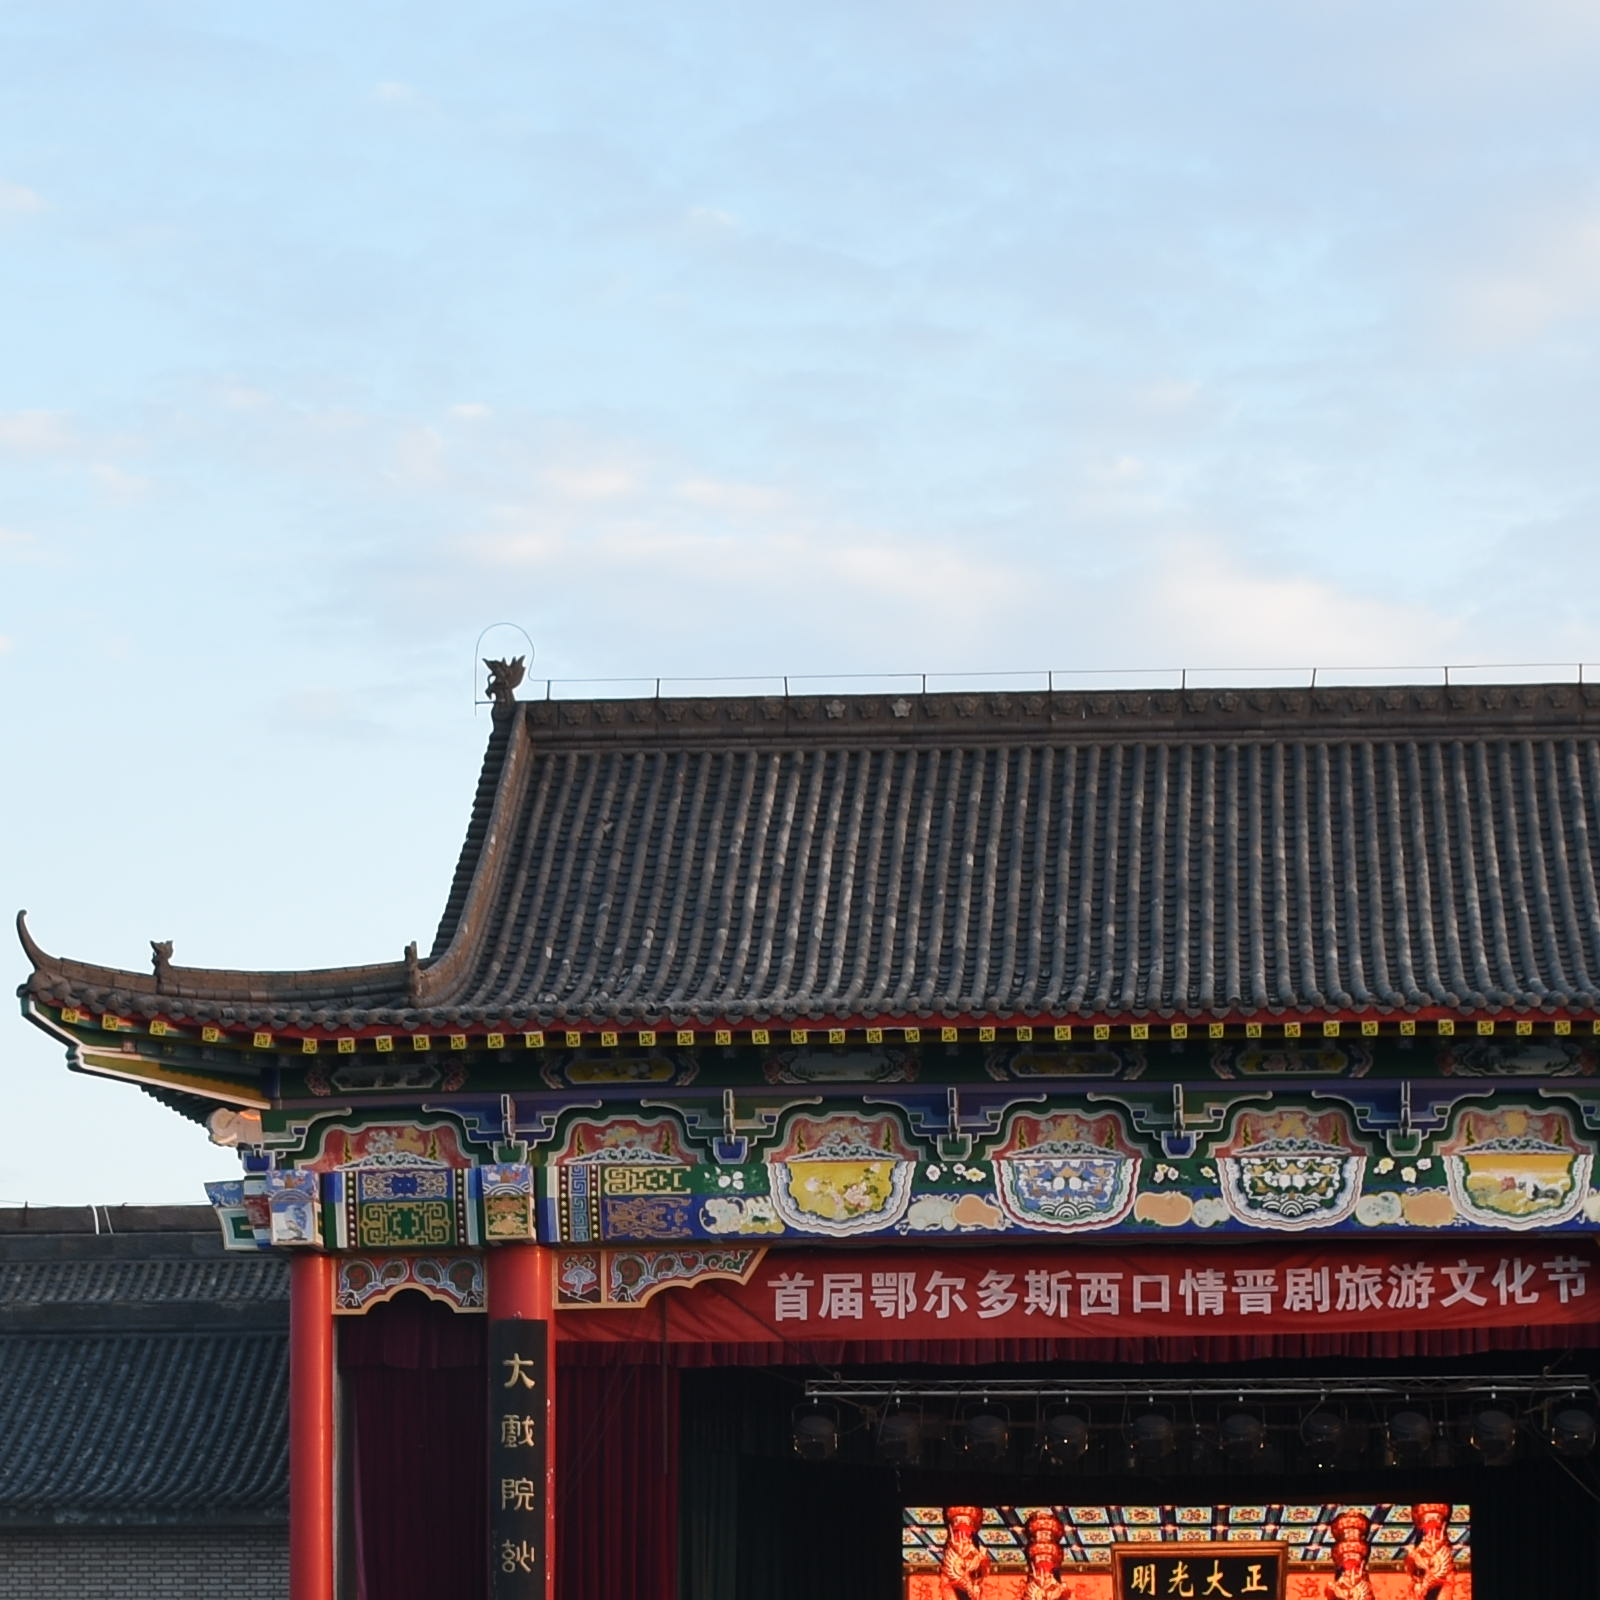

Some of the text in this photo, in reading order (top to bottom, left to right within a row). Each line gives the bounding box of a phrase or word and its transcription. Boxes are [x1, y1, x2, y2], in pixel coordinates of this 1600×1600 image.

[767, 1254, 1592, 1321] 首届鄂尔多斯西口情晋剧旅游文化节
